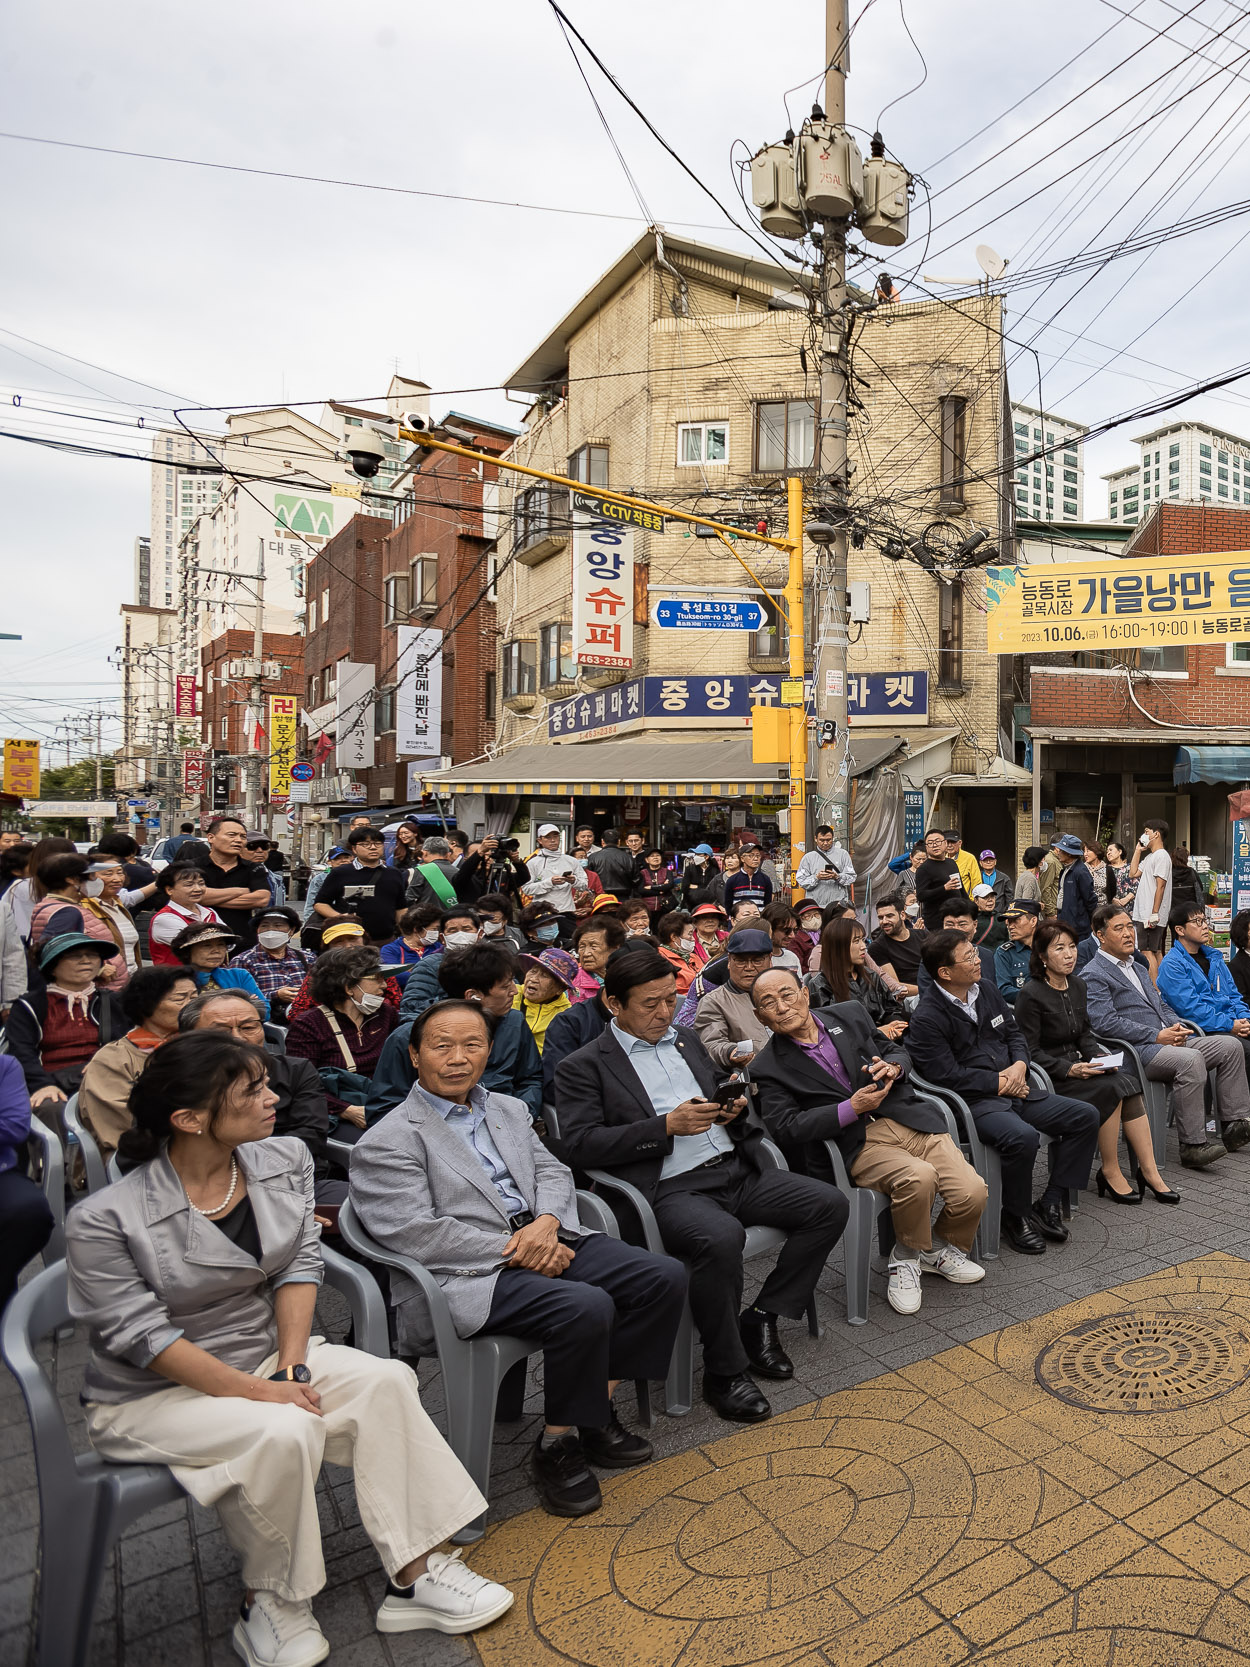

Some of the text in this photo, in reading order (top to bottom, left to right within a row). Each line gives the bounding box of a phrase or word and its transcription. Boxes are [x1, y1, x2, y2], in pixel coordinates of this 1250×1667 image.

[602, 502, 663, 531] CCTV 작동중
[585, 517, 627, 653] 중앙슈퍼
[1021, 579, 1073, 600] 능동로
[1077, 571, 1215, 615] 가을낭만
[659, 609, 671, 618] 33
[676, 612, 743, 622] Ttukseom-ro 30-gil
[681, 602, 738, 614] 뚝섬로30길
[748, 612, 758, 621] 37
[1021, 598, 1074, 617] 골목시장
[1021, 633, 1043, 643] 2023.
[1101, 620, 1189, 640] 16:00~19:00
[579, 655, 631, 668] 463-2384
[415, 694, 430, 721] 빠진
[552, 682, 640, 733] 중앙슈퍼마켓
[415, 723, 430, 737] 날
[578, 725, 617, 740] T.463-2384
[10, 749, 34, 793] 부동산
